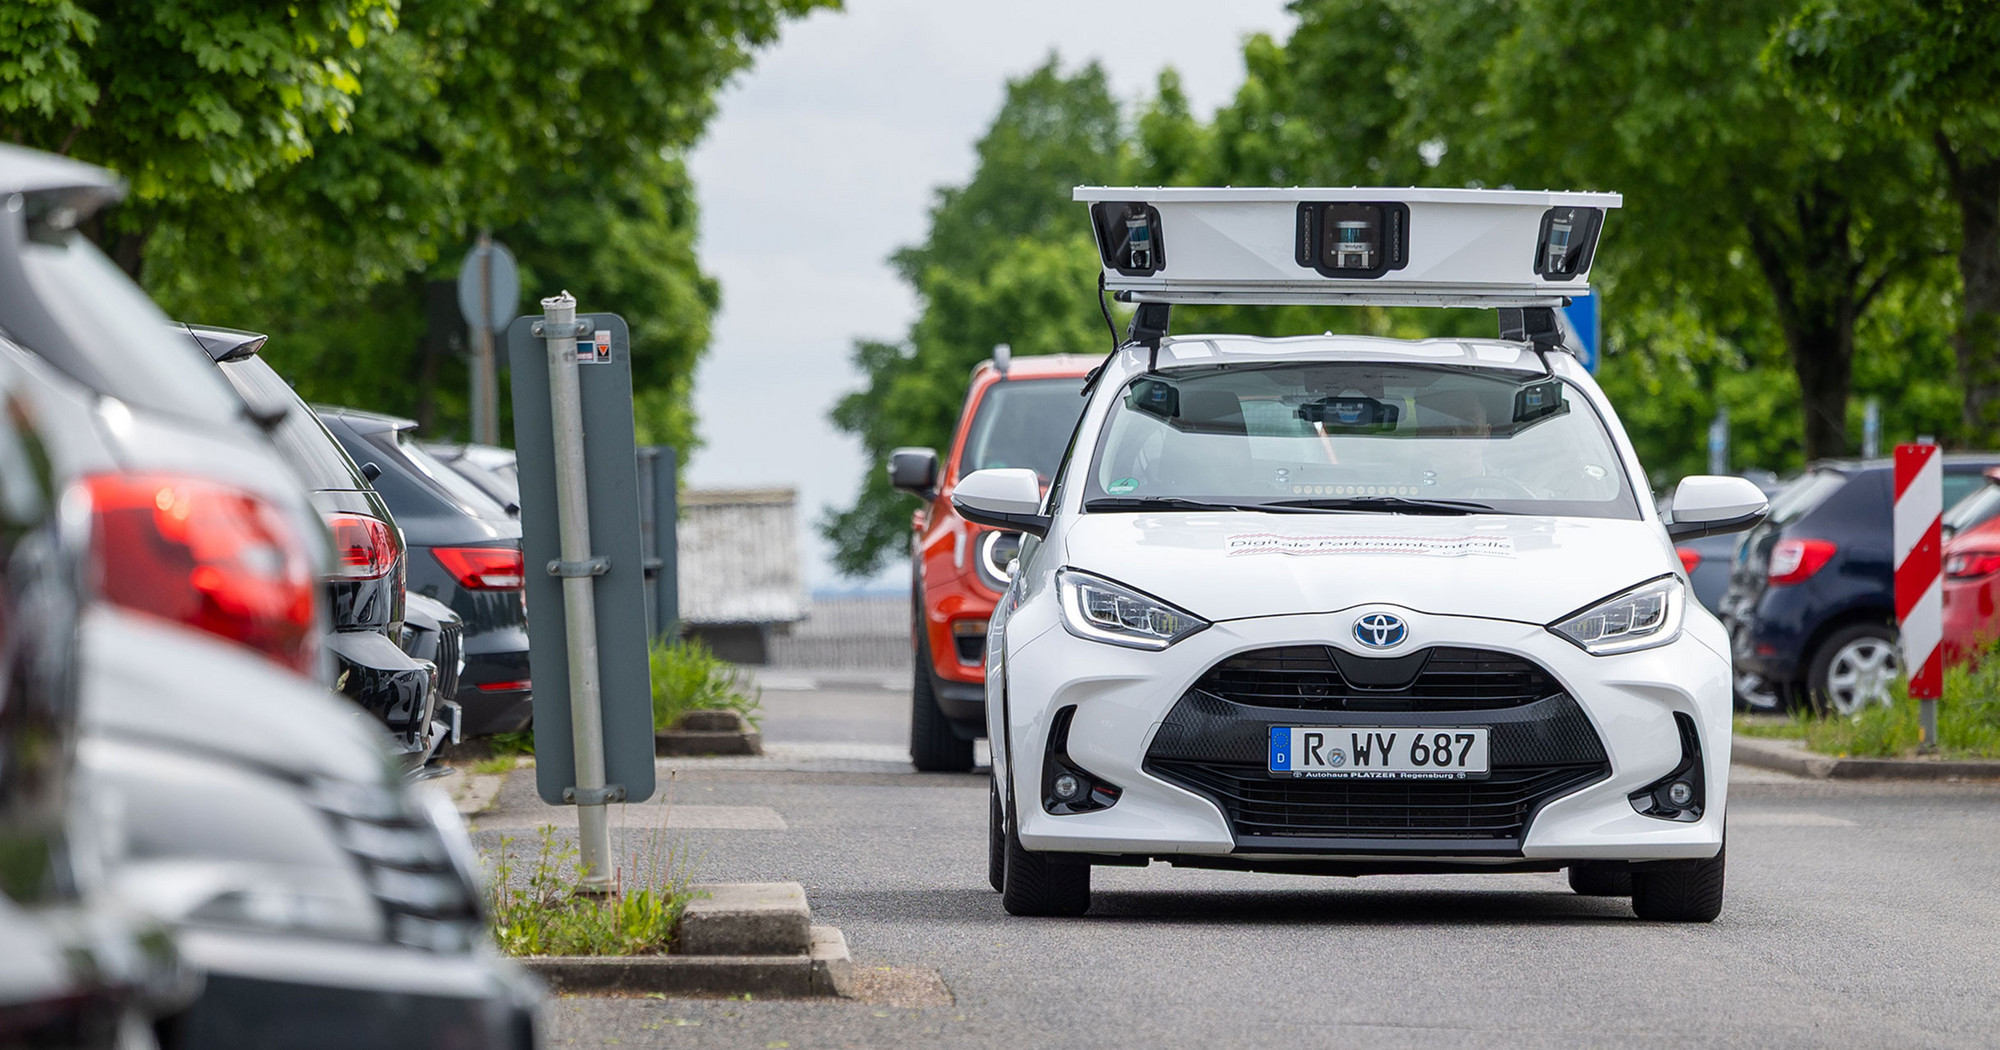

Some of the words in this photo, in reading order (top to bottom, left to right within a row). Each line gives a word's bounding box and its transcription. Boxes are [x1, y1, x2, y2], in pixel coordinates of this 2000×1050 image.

[1230, 539, 1311, 548] Digitale
[1319, 540, 1511, 549] Parkraumkontrolle
[1303, 732, 1325, 766] R
[1351, 732, 1397, 766] WY
[1410, 733, 1475, 767] 687
[1276, 753, 1285, 763] D
[1400, 772, 1454, 780] Regensburg
